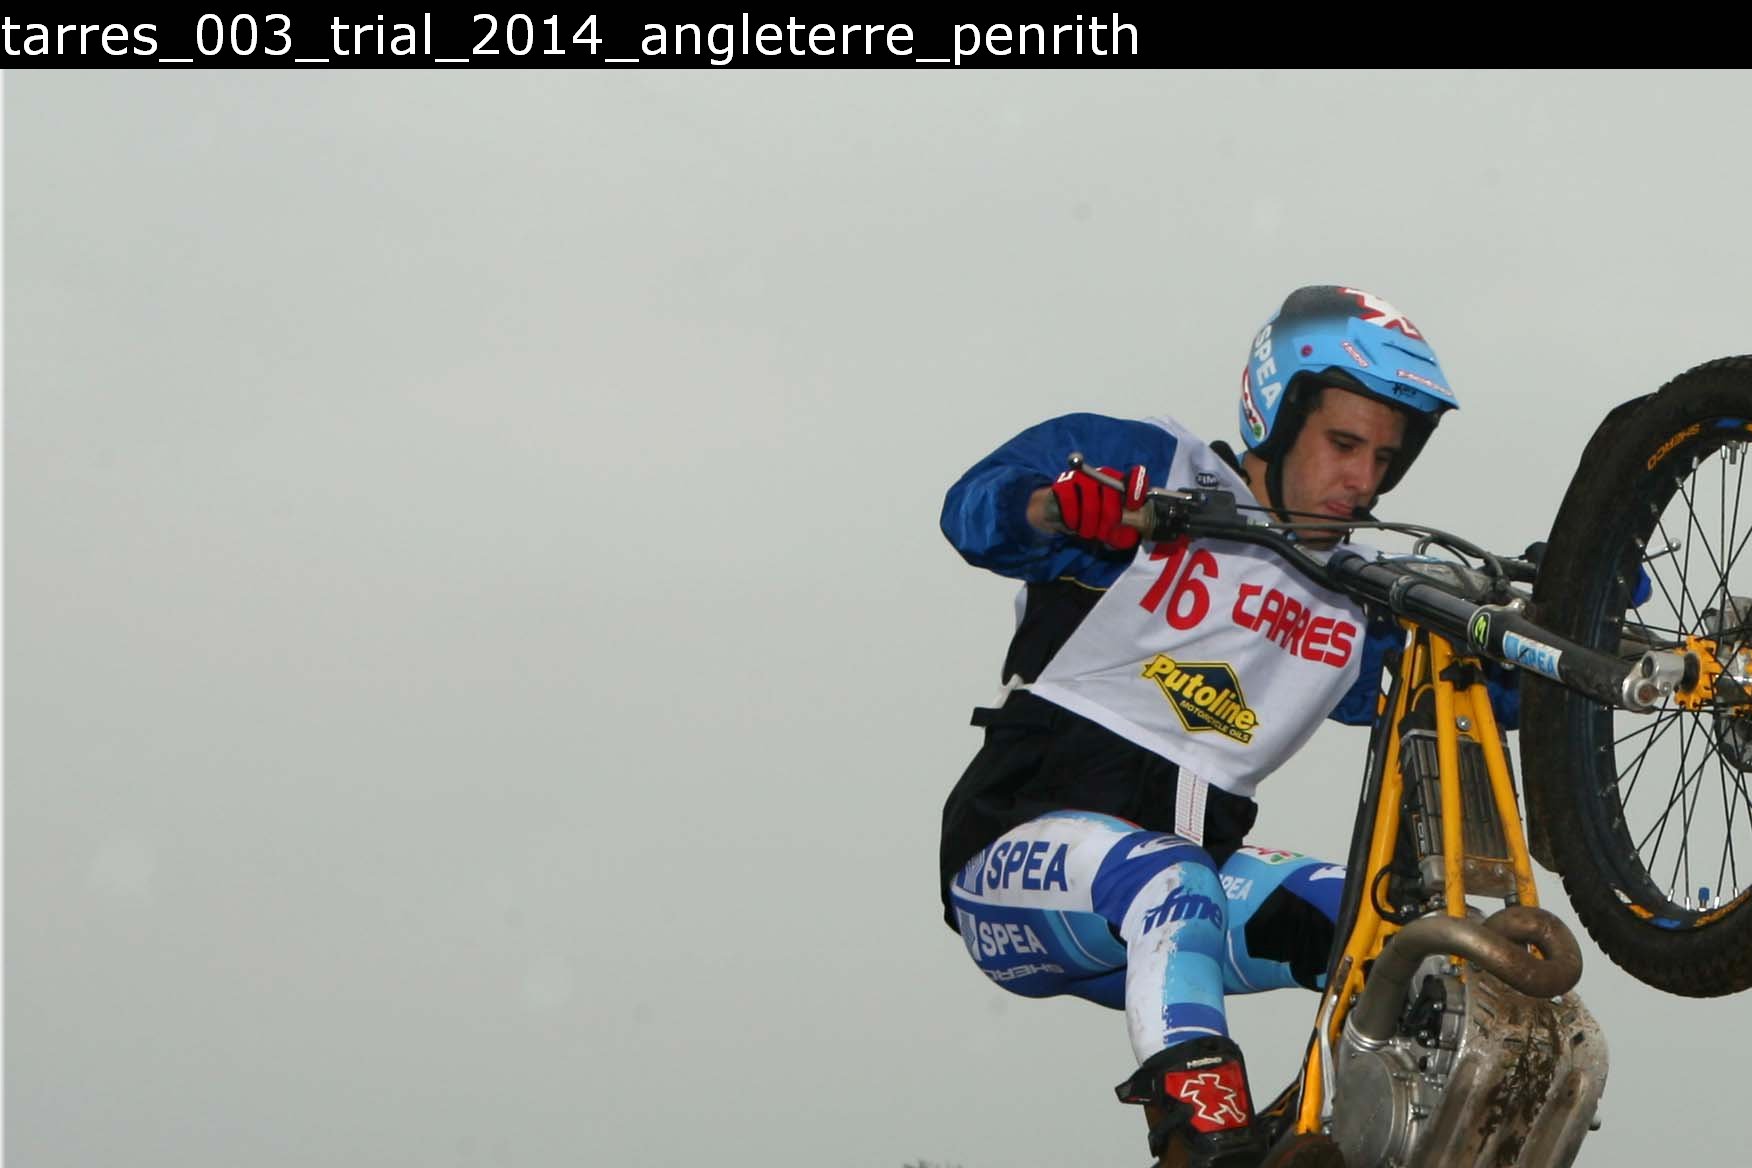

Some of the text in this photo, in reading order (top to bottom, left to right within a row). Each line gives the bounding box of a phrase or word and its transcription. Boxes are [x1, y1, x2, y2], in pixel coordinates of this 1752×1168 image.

[1254, 324, 1282, 409] SPEA
[1142, 653, 1258, 731] Putoline
[1180, 700, 1251, 742] MOTORCYCLE OILS
[987, 841, 1069, 892] SPEA
[1219, 873, 1253, 900] PEA
[979, 921, 1048, 957] SPEA
